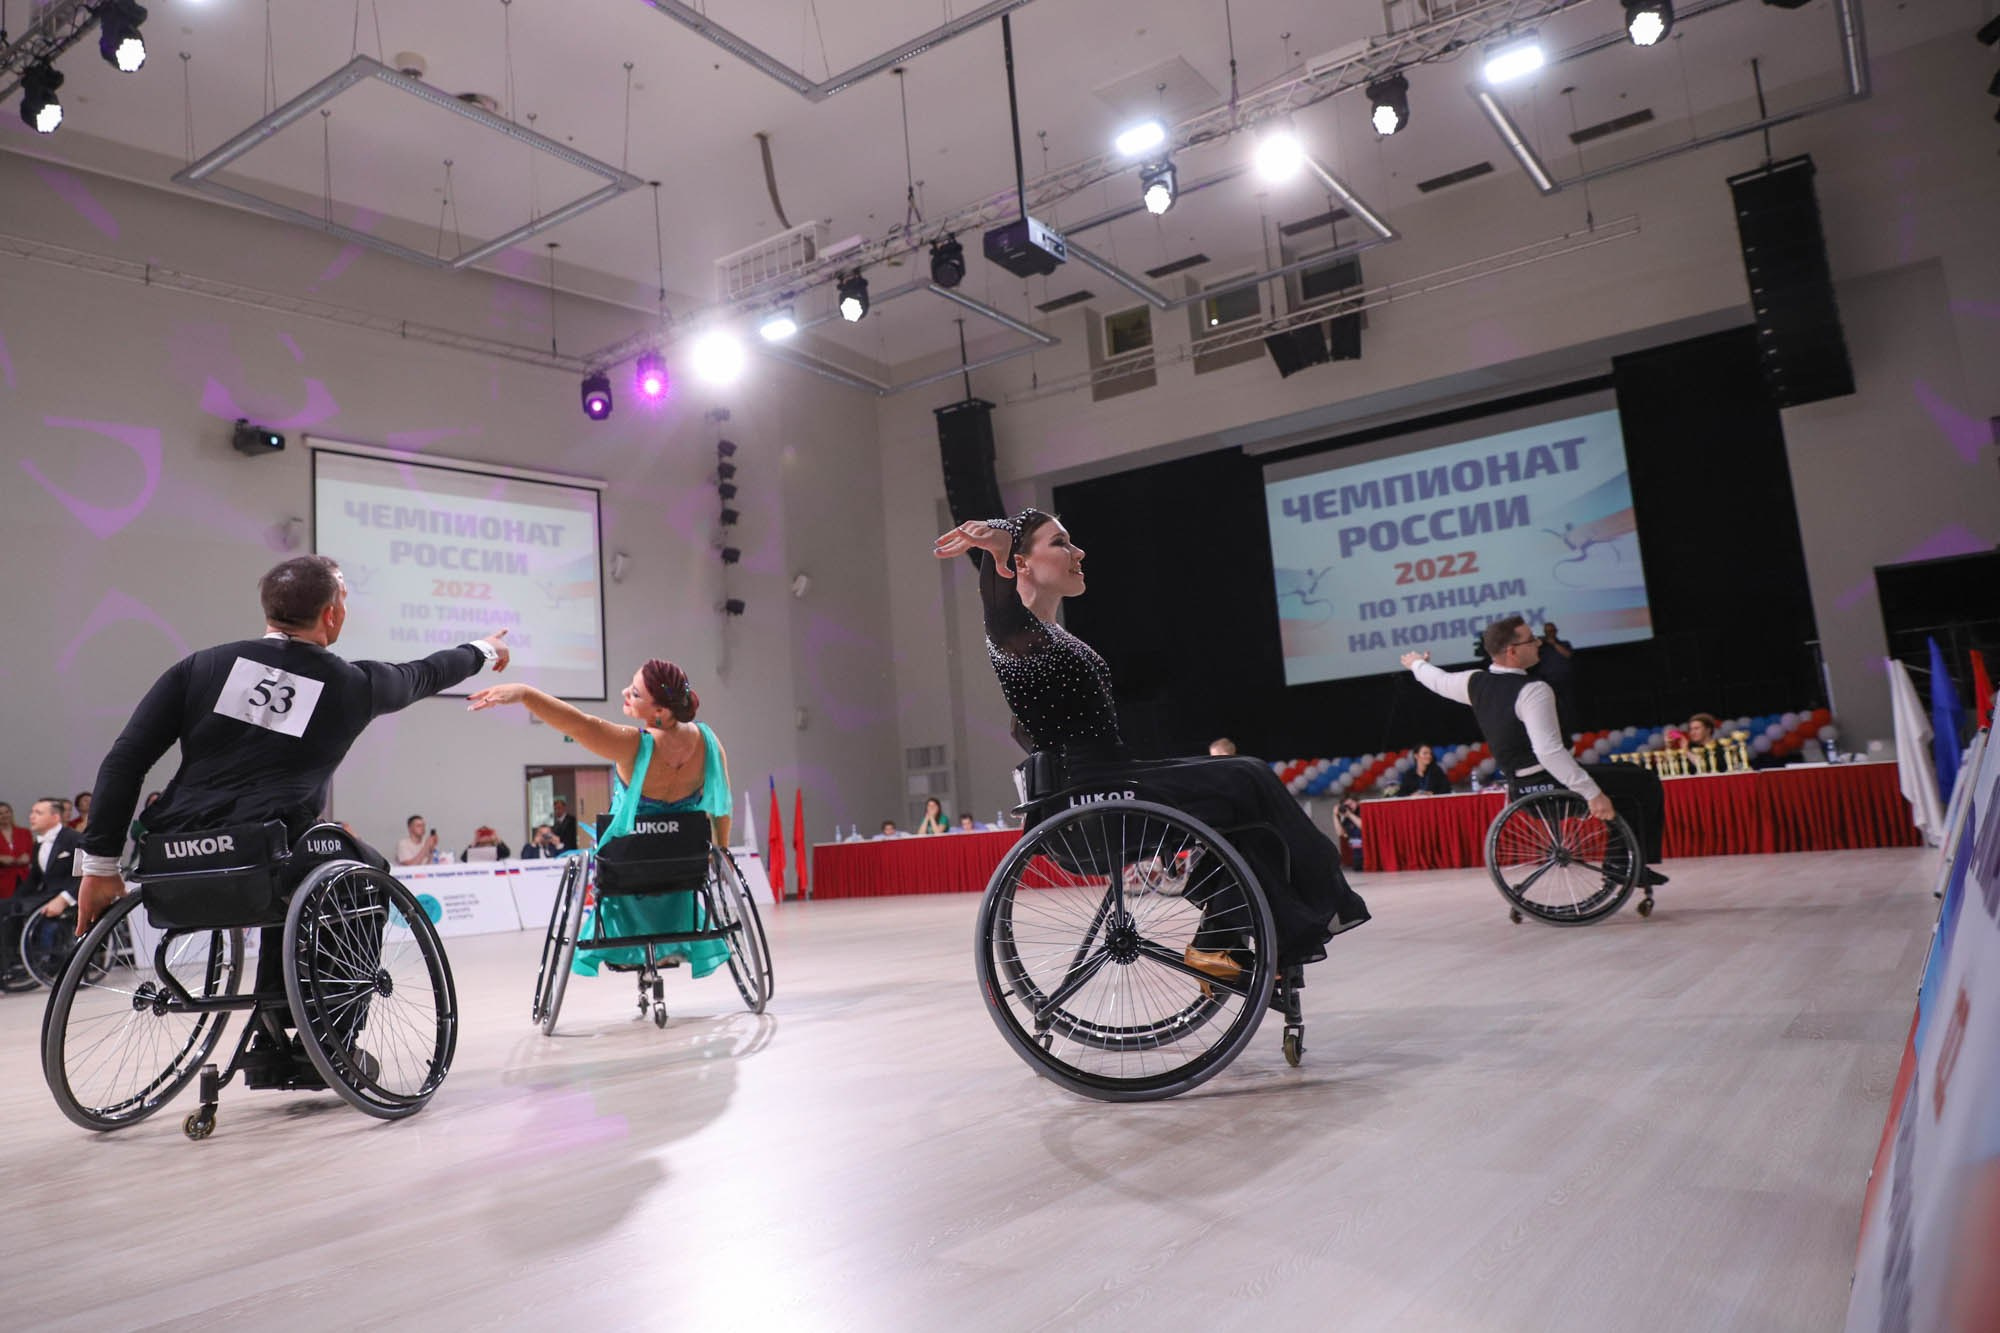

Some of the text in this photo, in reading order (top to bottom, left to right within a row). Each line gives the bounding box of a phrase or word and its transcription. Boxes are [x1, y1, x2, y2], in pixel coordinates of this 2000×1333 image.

[1282, 437, 1586, 524] ЧЕМПИОНАТ
[344, 499, 566, 547] ЧЕМПИОНАТ
[1339, 494, 1531, 558] РОССИИ
[389, 540, 529, 575] РОССИИ
[1394, 551, 1480, 585] 2022
[431, 579, 493, 600] 2022
[1358, 577, 1527, 621] ПО ТАНЦАМ
[400, 602, 521, 624] ПО ТАНЦАМ
[390, 627, 419, 641] НА
[1348, 607, 1547, 654] НА КОЛЯСХ
[248, 679, 296, 714] 53
[1069, 790, 1136, 809] LUKOR
[164, 835, 234, 859] LUKOR
[307, 839, 342, 853] LUKOR
